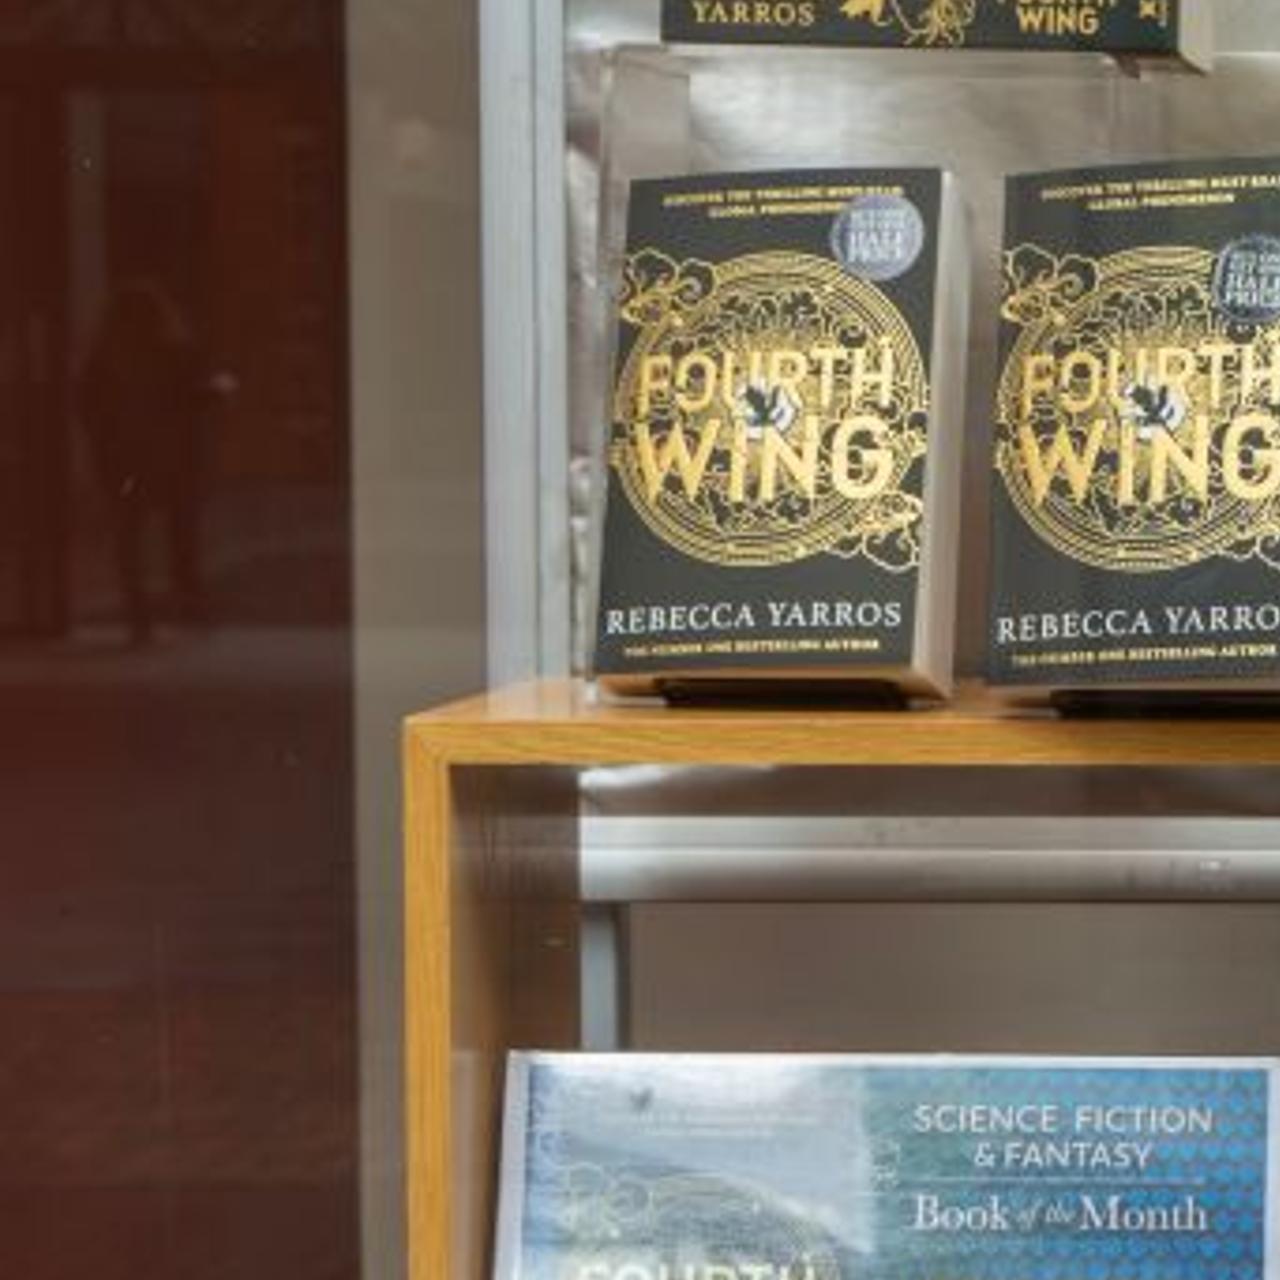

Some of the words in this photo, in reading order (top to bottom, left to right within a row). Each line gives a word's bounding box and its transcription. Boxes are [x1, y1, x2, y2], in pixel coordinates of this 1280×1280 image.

[692, 1, 816, 27] YARROS
[1016, 4, 1100, 36] WING
[635, 345, 895, 418] FOURTH
[632, 413, 895, 504] WING
[605, 603, 756, 636] REBECCA
[767, 600, 903, 629] YARROS
[997, 610, 1153, 645] REBECCA
[913, 1104, 1060, 1134] SCIENCE
[1075, 1104, 1214, 1134] FICTION
[973, 1141, 996, 1168] &
[1004, 1141, 1154, 1168] FANTASY
[913, 1193, 1009, 1232] Book
[1015, 1200, 1043, 1231] of
[1045, 1199, 1077, 1225] the
[1079, 1193, 1208, 1232] Month
